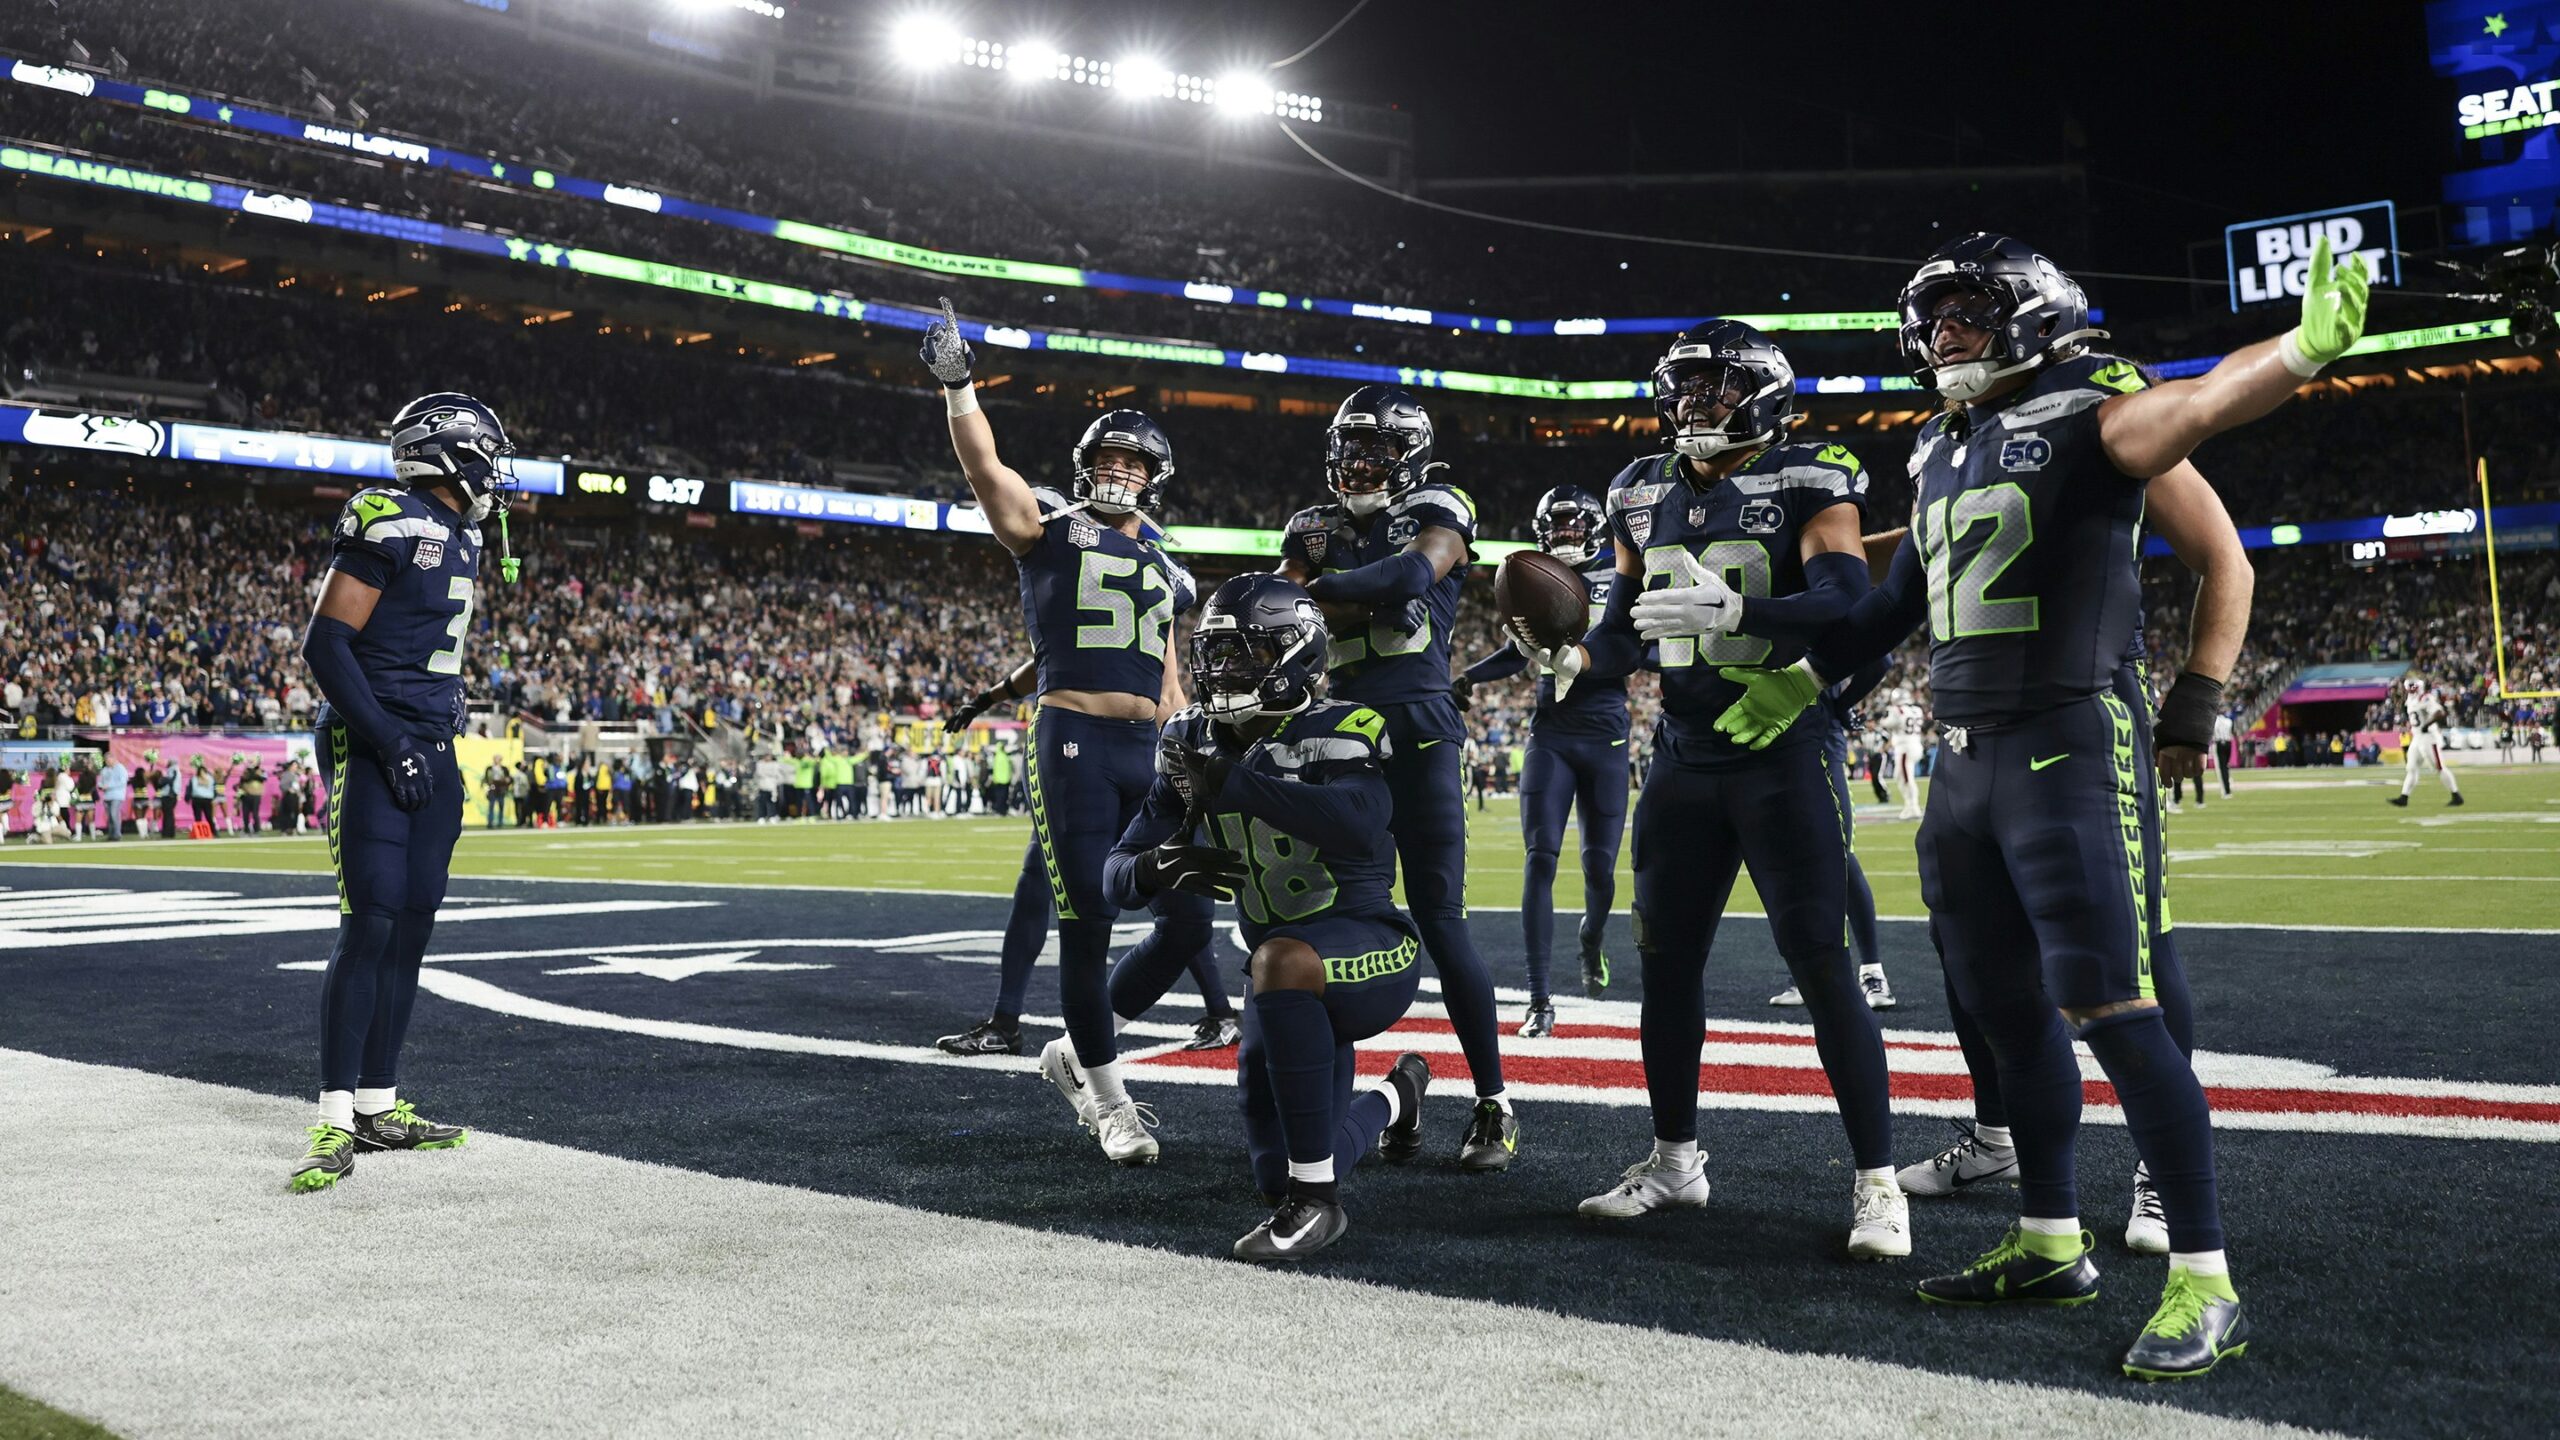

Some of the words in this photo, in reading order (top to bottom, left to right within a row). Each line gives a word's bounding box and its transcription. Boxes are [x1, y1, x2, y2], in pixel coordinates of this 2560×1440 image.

[2458, 80, 2560, 126] SEAT
[0, 148, 213, 203] SEAHAWKS
[2256, 217, 2364, 266] BUD
[893, 249, 1007, 273] SEAHAWKS
[2239, 248, 2388, 304] LIGT
[1046, 334, 1099, 353] SEATTLE
[1100, 339, 1226, 366] SEAHAWKS
[2015, 402, 2062, 419] SEAHAWKS
[2000, 438, 2051, 469] 50
[578, 473, 613, 493] QTR
[613, 476, 628, 494] 4
[648, 476, 704, 504] 8:37
[1073, 523, 1097, 537] USA
[1388, 519, 1420, 543] 50
[1629, 516, 1649, 525] USA
[1740, 504, 1784, 532] 50
[418, 543, 440, 552] USA
[1304, 536, 1325, 546] USA
[414, 553, 441, 565] 250
[1912, 482, 2039, 641] 42
[1077, 551, 1174, 663] 52
[427, 576, 474, 675] 3
[1174, 780, 1190, 789] US
